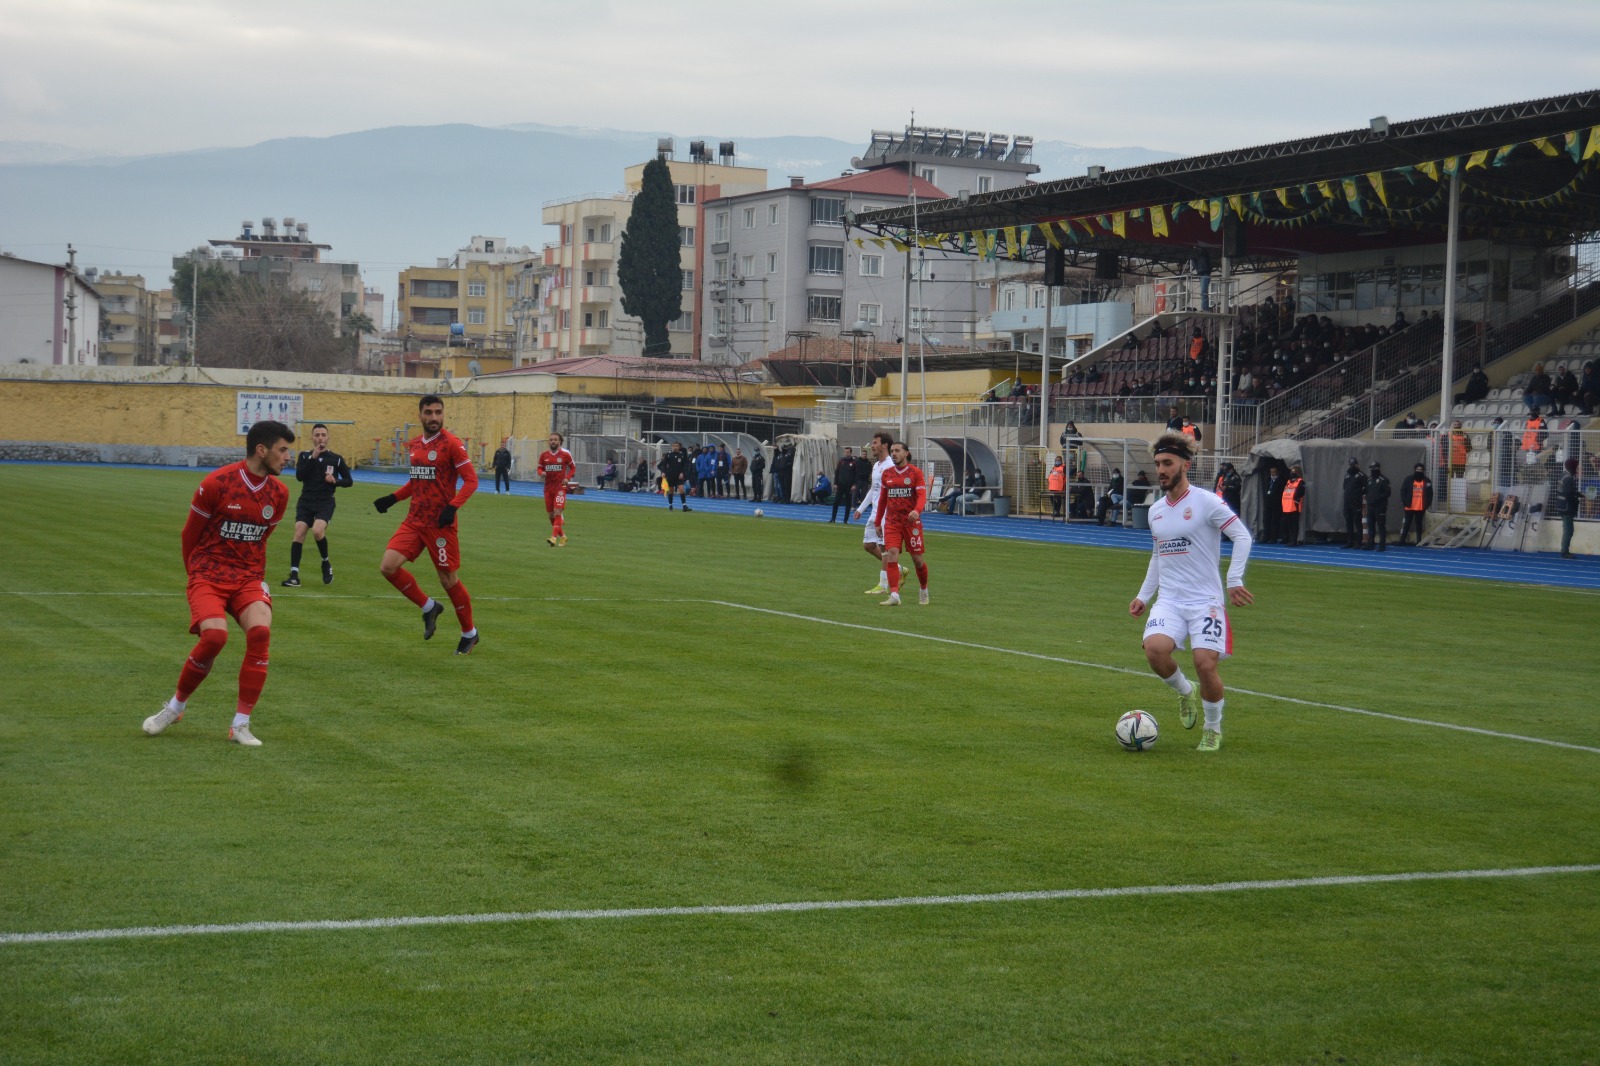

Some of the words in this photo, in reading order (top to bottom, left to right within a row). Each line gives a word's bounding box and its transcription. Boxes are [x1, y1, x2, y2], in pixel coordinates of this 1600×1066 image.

[255, 412, 261, 420] 2
[268, 413, 274, 421] 3
[556, 496, 564, 504] 60
[910, 536, 922, 547] 64
[439, 548, 447, 562] 8
[1202, 617, 1222, 637] 25
